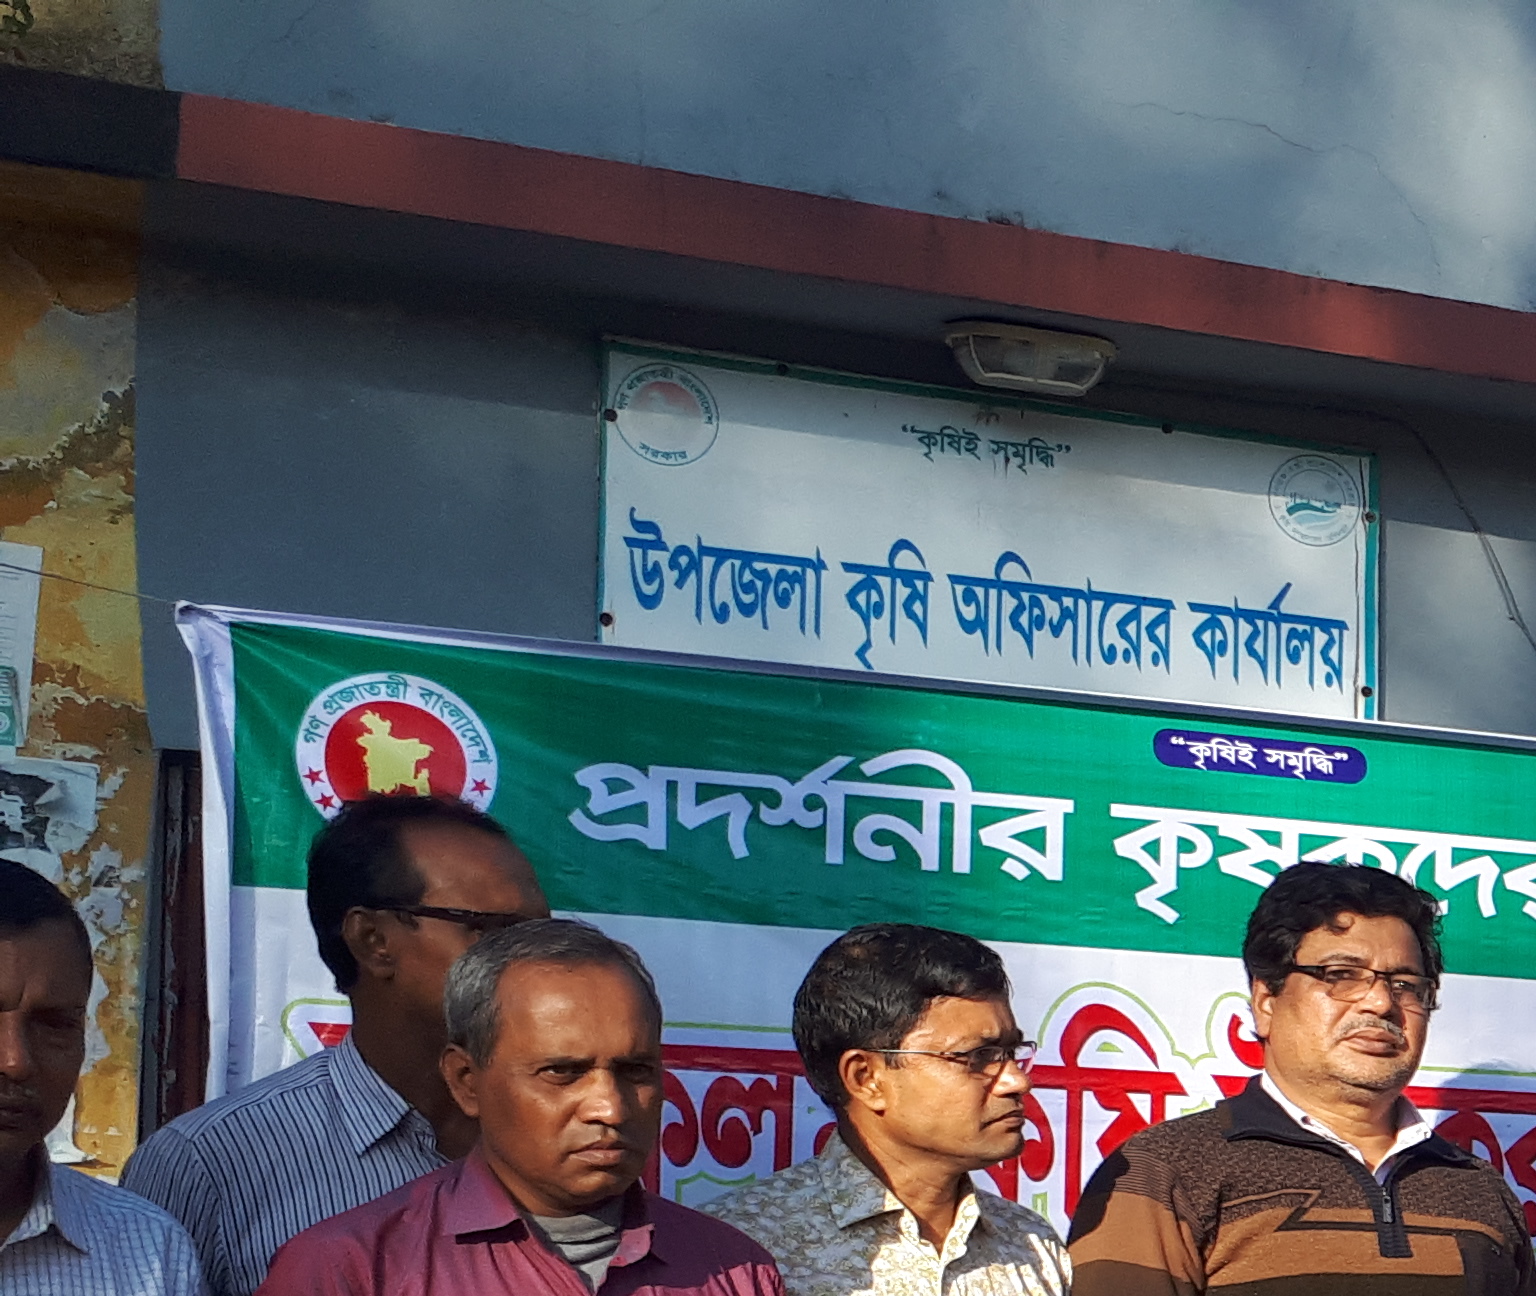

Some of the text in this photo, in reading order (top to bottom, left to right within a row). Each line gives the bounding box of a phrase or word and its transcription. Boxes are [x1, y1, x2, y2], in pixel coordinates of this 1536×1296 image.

[623, 507, 1348, 695] উপজেলা কৃষি অফিসারের কার্যালয়
[303, 714, 331, 744] গণ
[418, 685, 494, 765] বাংলাদেশ
[568, 747, 1075, 883] প্রদর্শনীর
